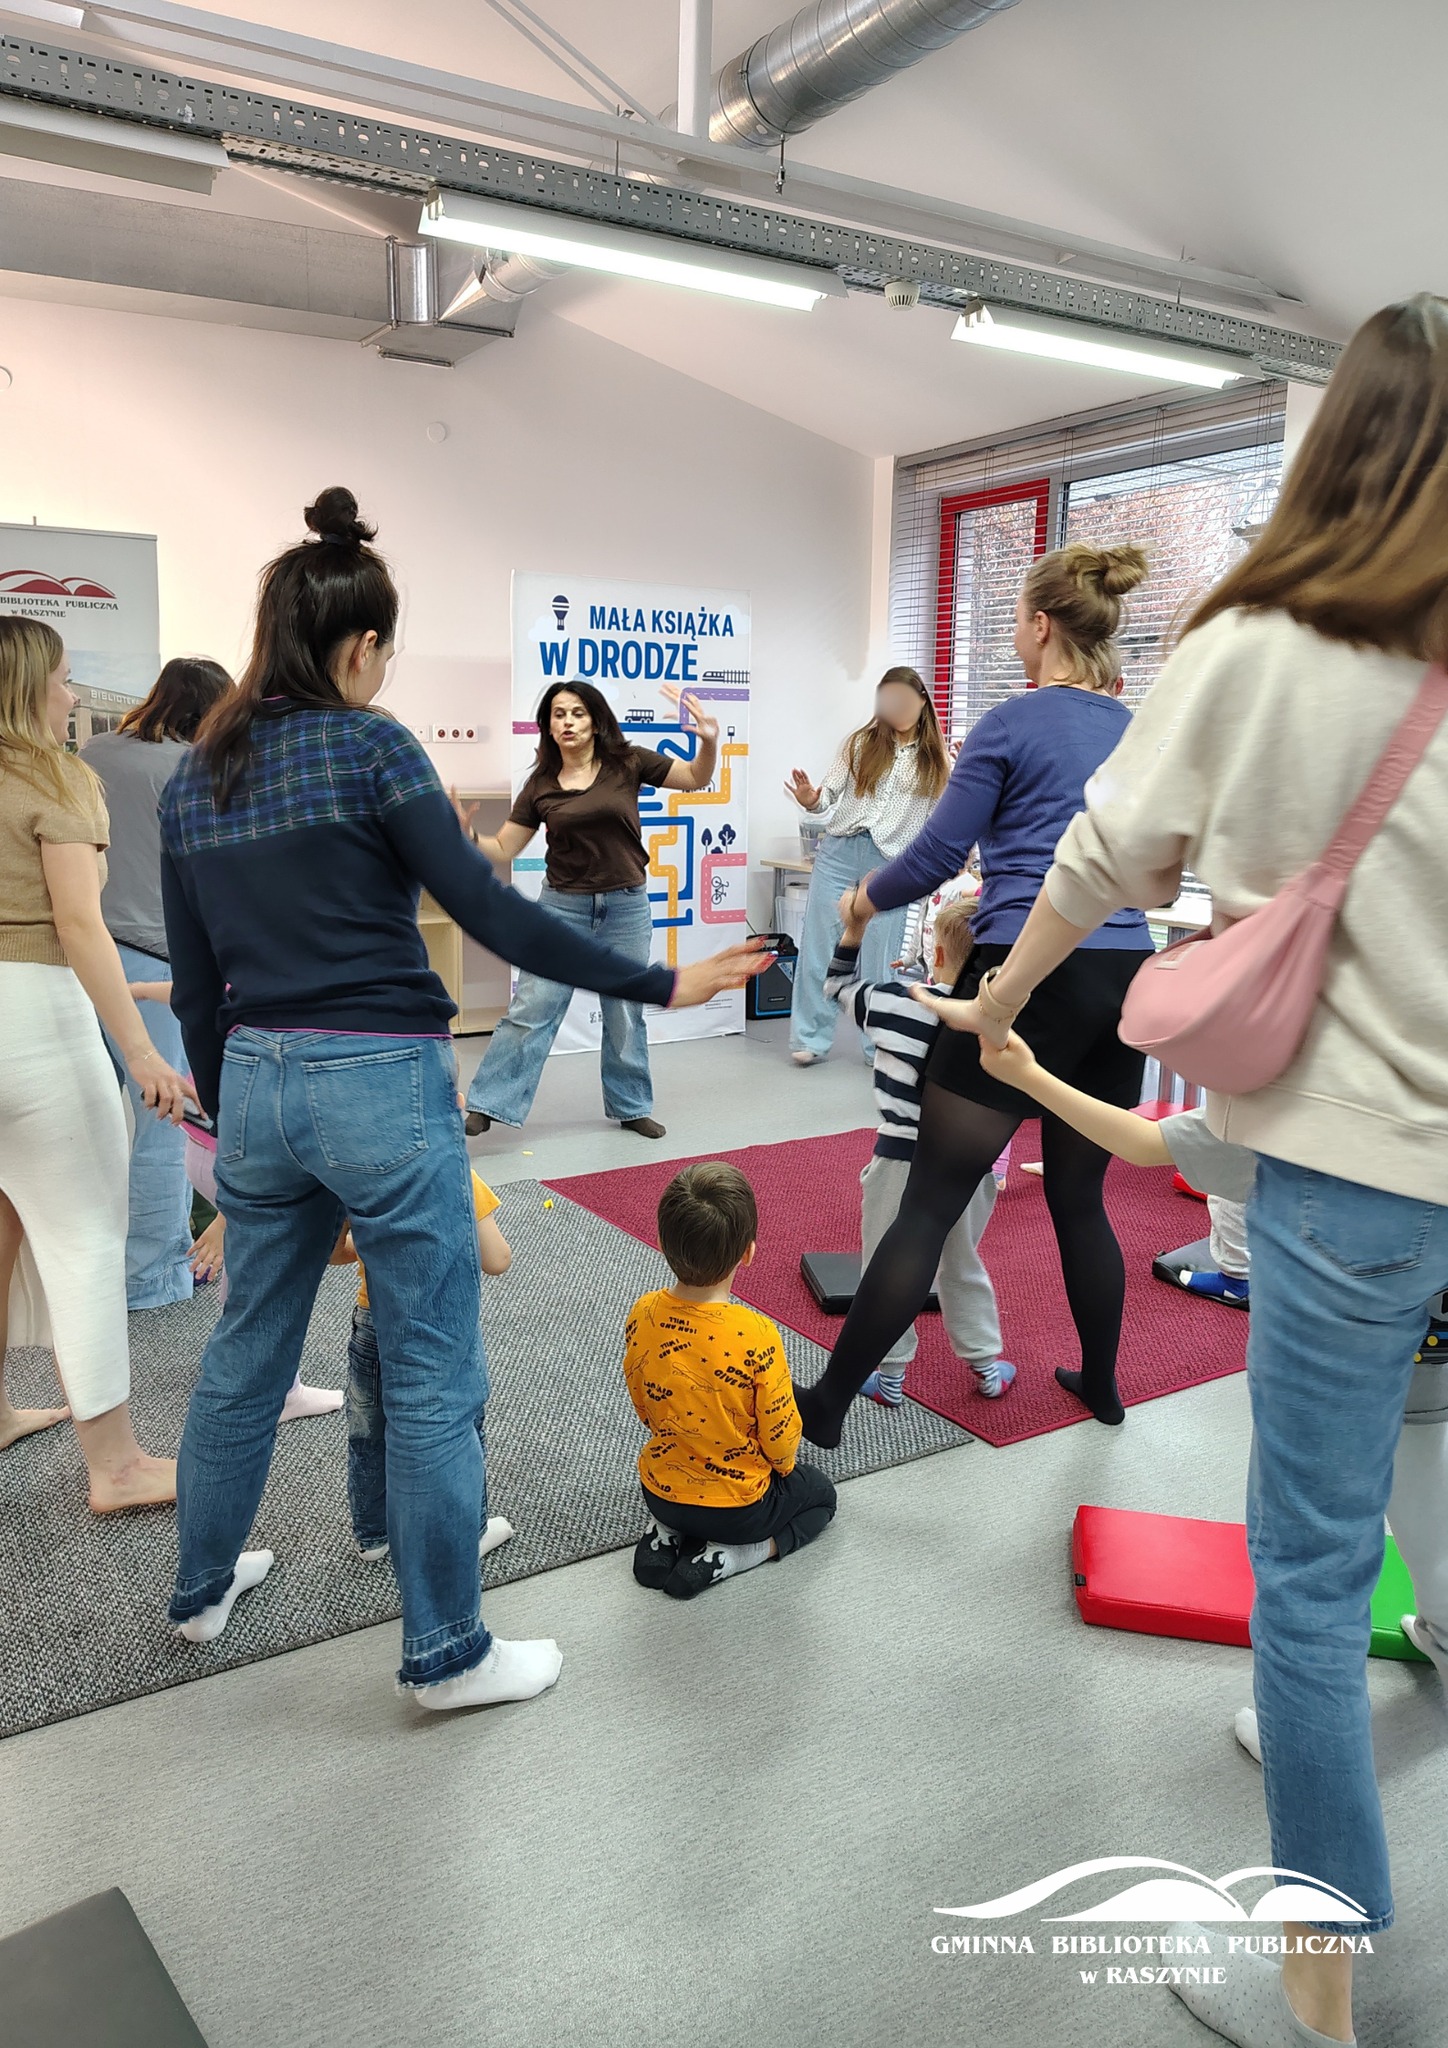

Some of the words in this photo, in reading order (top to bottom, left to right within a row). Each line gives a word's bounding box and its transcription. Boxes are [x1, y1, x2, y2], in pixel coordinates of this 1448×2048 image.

[21, 608, 66, 618] RASZYNIE
[66, 600, 119, 610] PUBLICZNA
[589, 605, 646, 632] MAŁA
[651, 606, 735, 641] KSIĄŻKA
[539, 637, 570, 676] W
[578, 638, 698, 681] DRODZE
